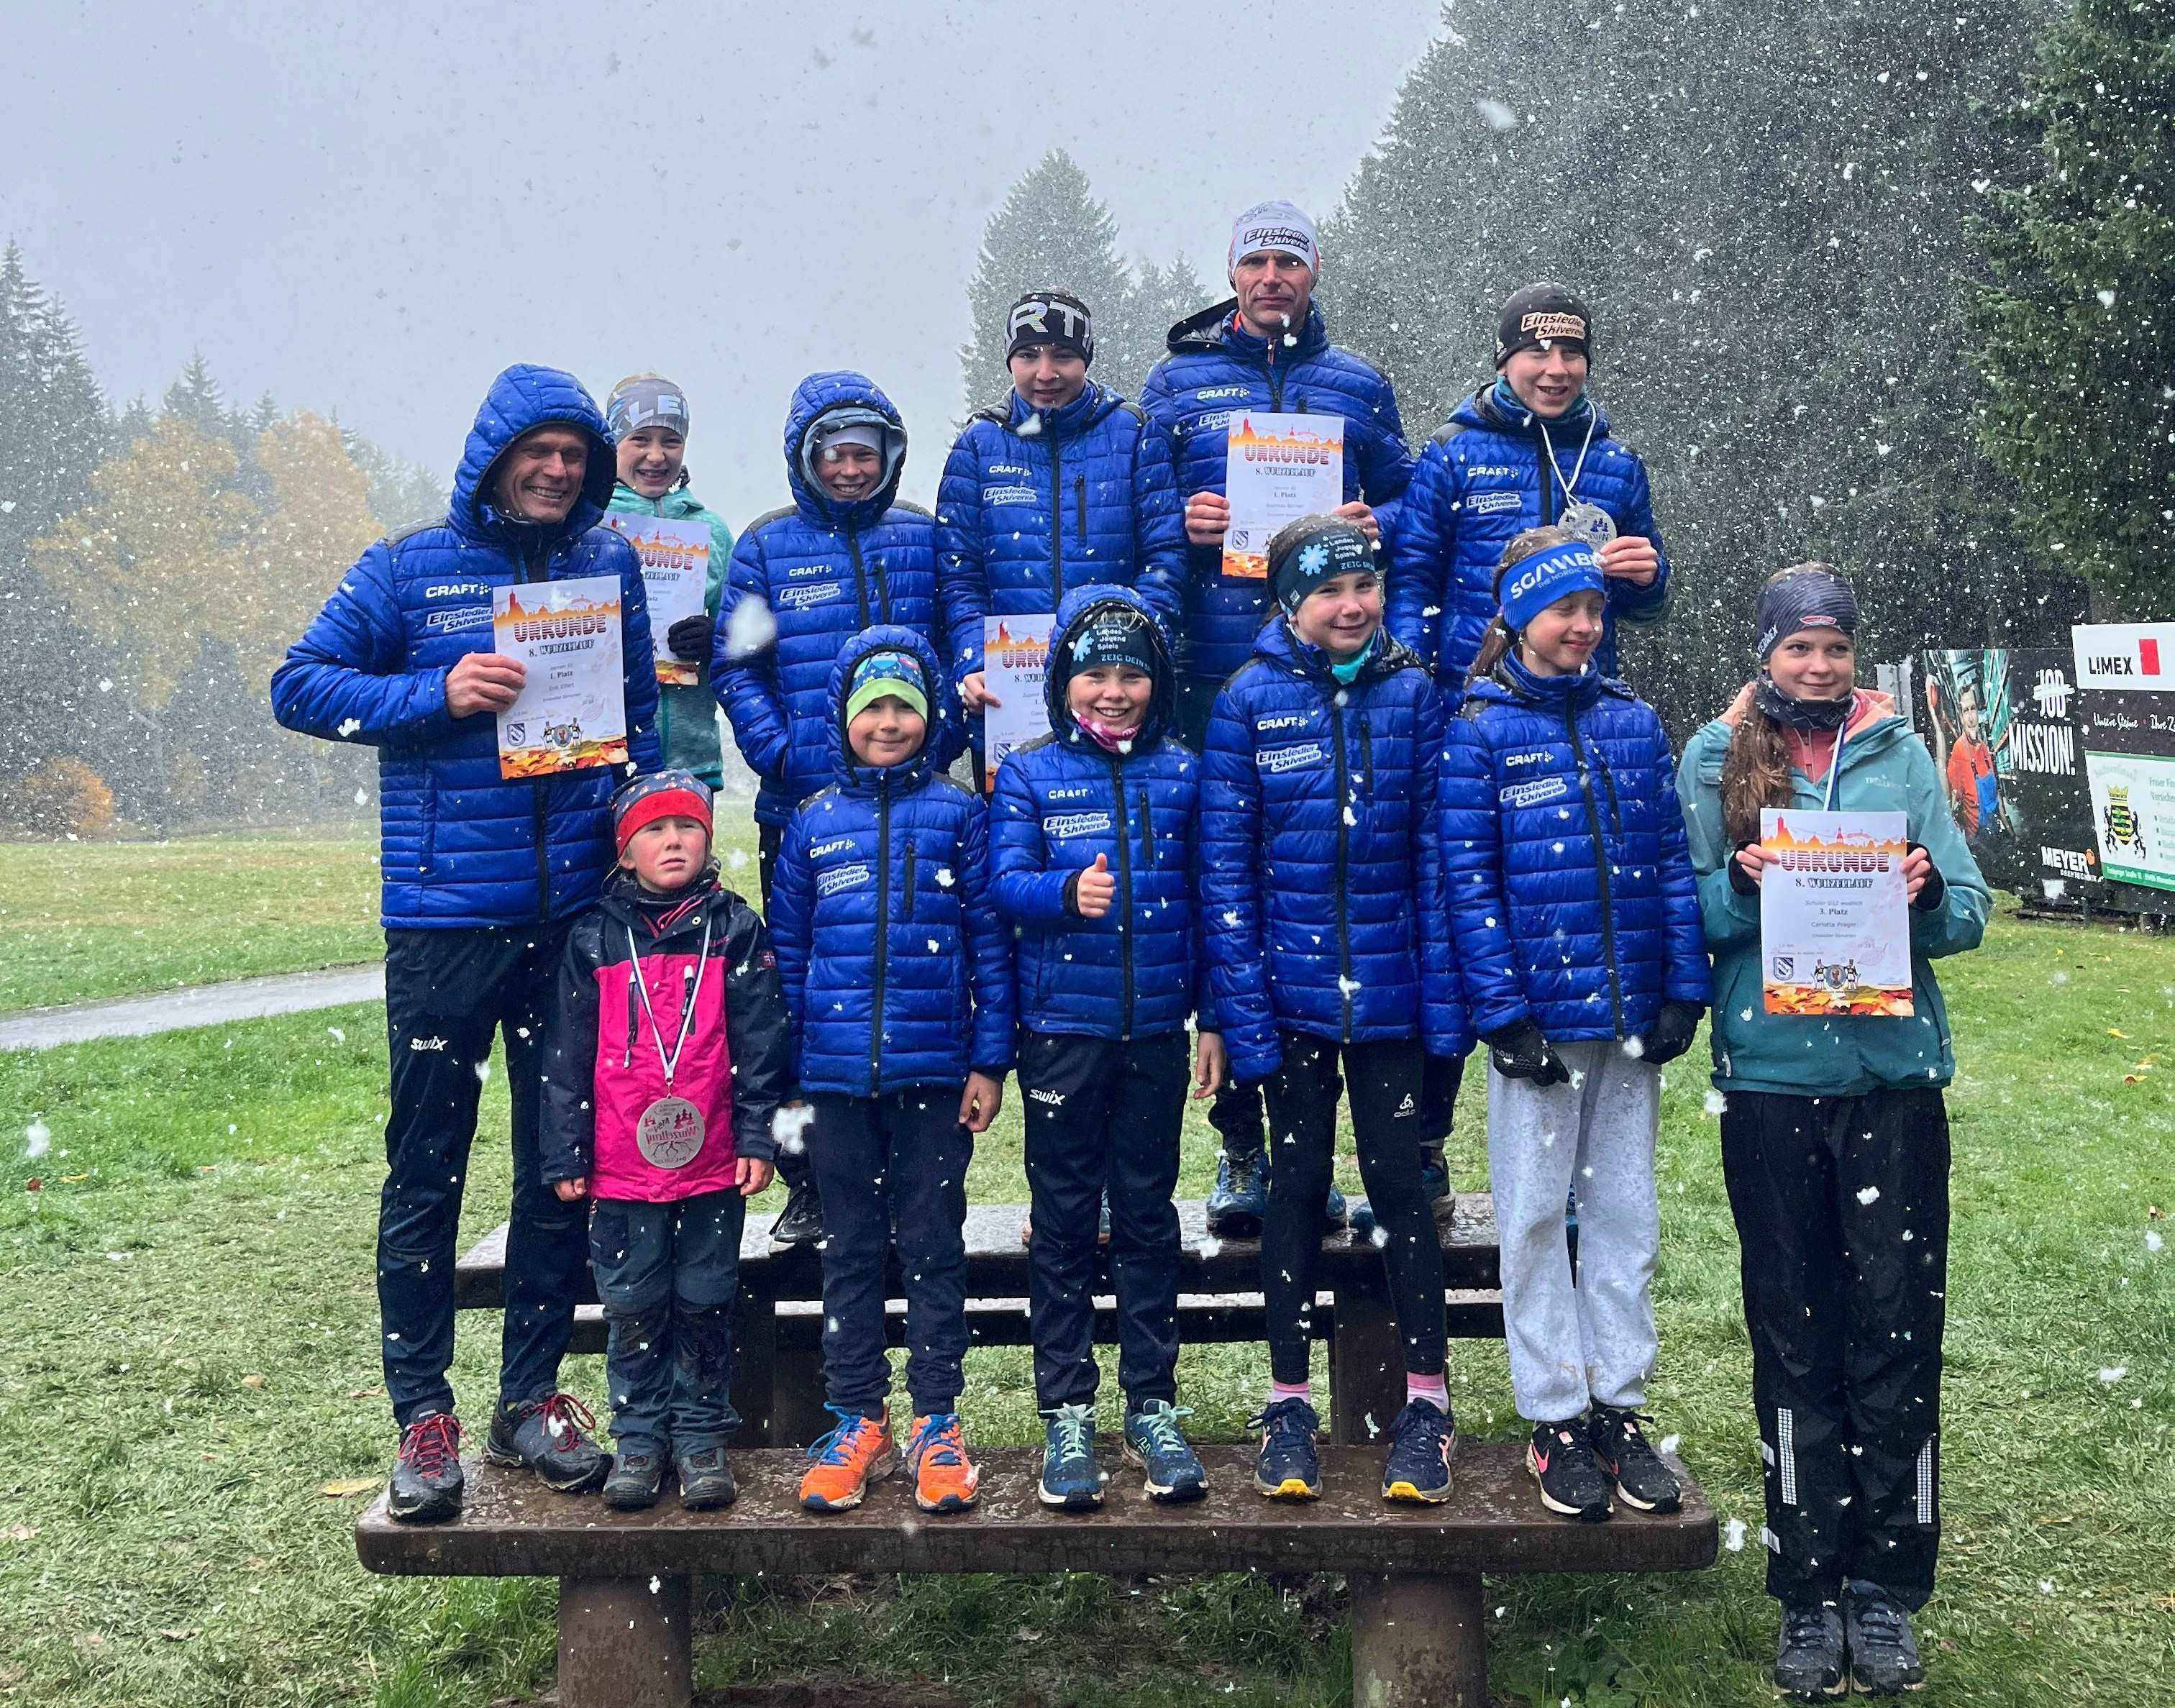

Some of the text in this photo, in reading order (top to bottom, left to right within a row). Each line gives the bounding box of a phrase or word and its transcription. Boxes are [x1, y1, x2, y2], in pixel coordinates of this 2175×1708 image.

[1523, 314, 1582, 328] Einsiedle
[1538, 324, 1584, 337] Skivere
[1196, 388, 1239, 400] CRAFT
[1200, 412, 1231, 424] Einsi
[1244, 444, 1330, 465] URKUNDE
[988, 465, 1023, 475] CRAFT
[1467, 466, 1509, 477] CRAFT
[638, 549, 693, 570] UNDE
[788, 565, 824, 576] CRAFT
[426, 583, 479, 598] CRAFT
[445, 615, 493, 631] Skiverei
[514, 613, 607, 641] URKUNDE
[539, 639, 595, 655] WURZELLAUF
[1257, 716, 1297, 731] CRAFT
[2008, 723, 2076, 775] MISSION!
[1505, 752, 1543, 767] CRAFT
[1503, 781, 1561, 799] Einsiedler
[1046, 815, 1105, 828] Einsiedler
[810, 840, 845, 859] CRAFT
[1781, 849, 1889, 873] URKUNDE
[2041, 846, 2089, 875] MEYER
[1795, 877, 1874, 889] 8. WURZELLAUF
